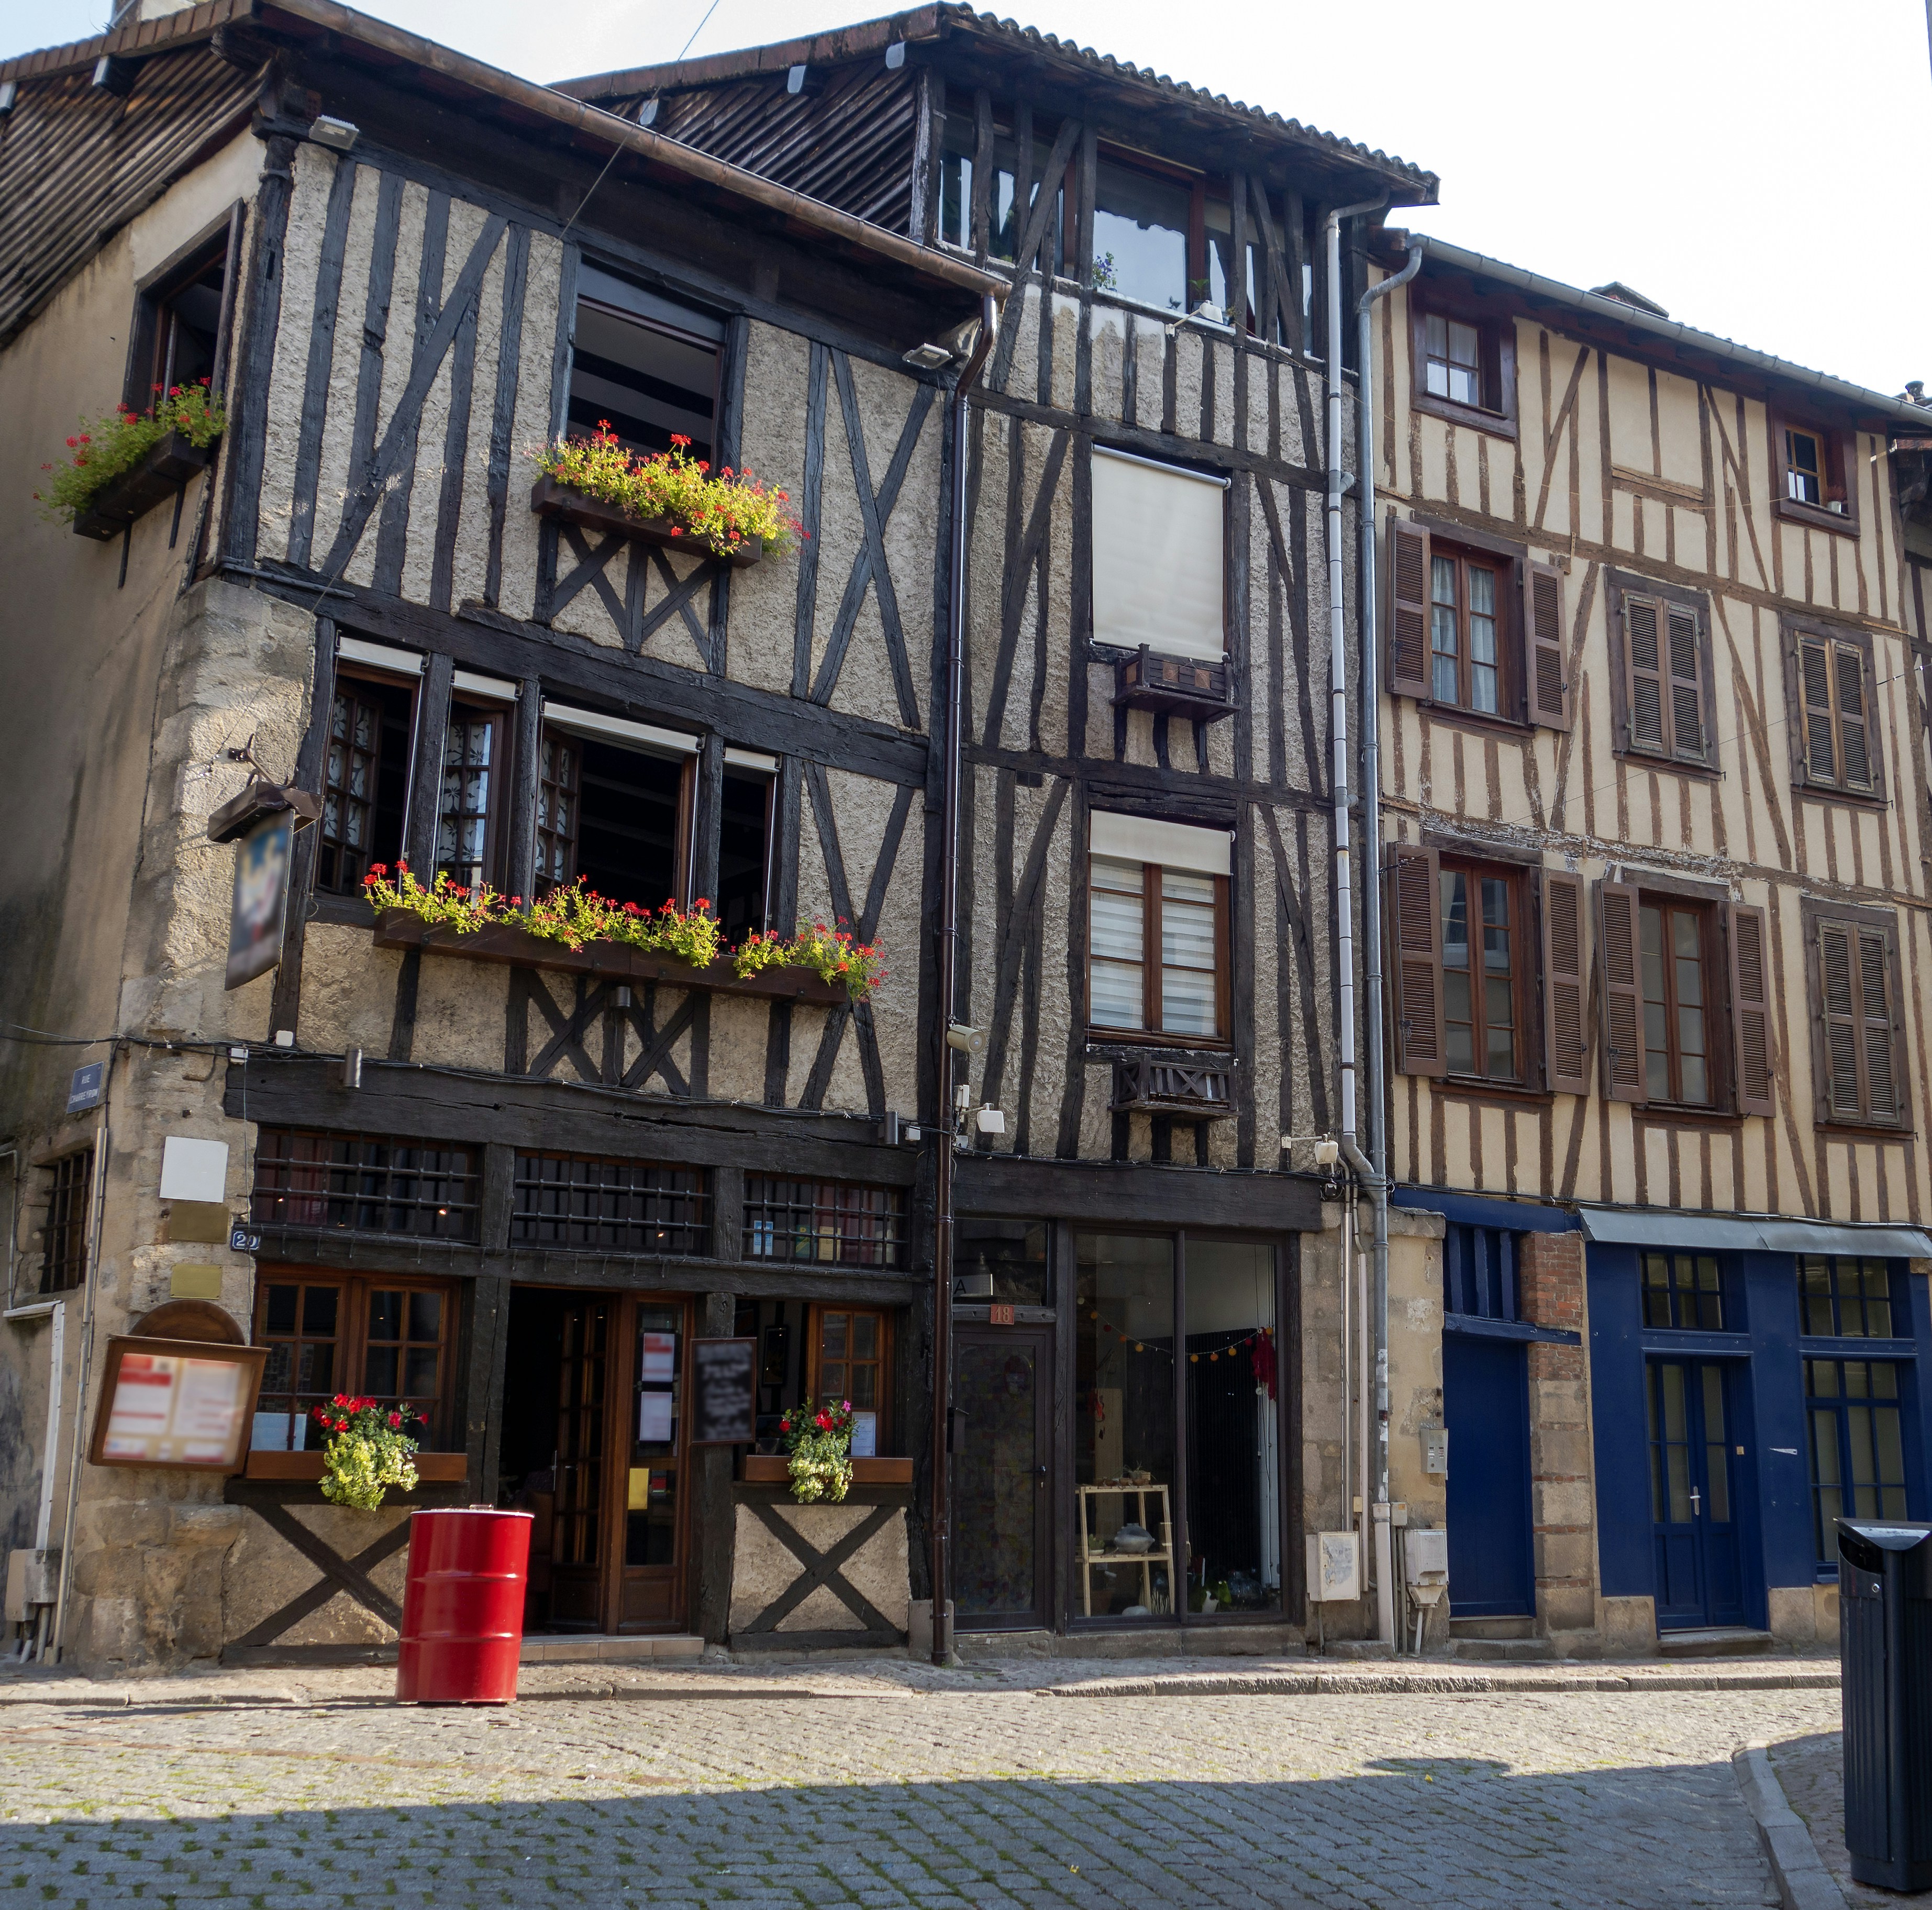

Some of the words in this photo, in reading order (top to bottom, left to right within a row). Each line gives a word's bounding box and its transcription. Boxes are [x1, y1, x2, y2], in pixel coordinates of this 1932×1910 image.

[82, 1074, 91, 1085] RUE
[236, 1234, 257, 1247] 20
[995, 1306, 1010, 1323] 18
